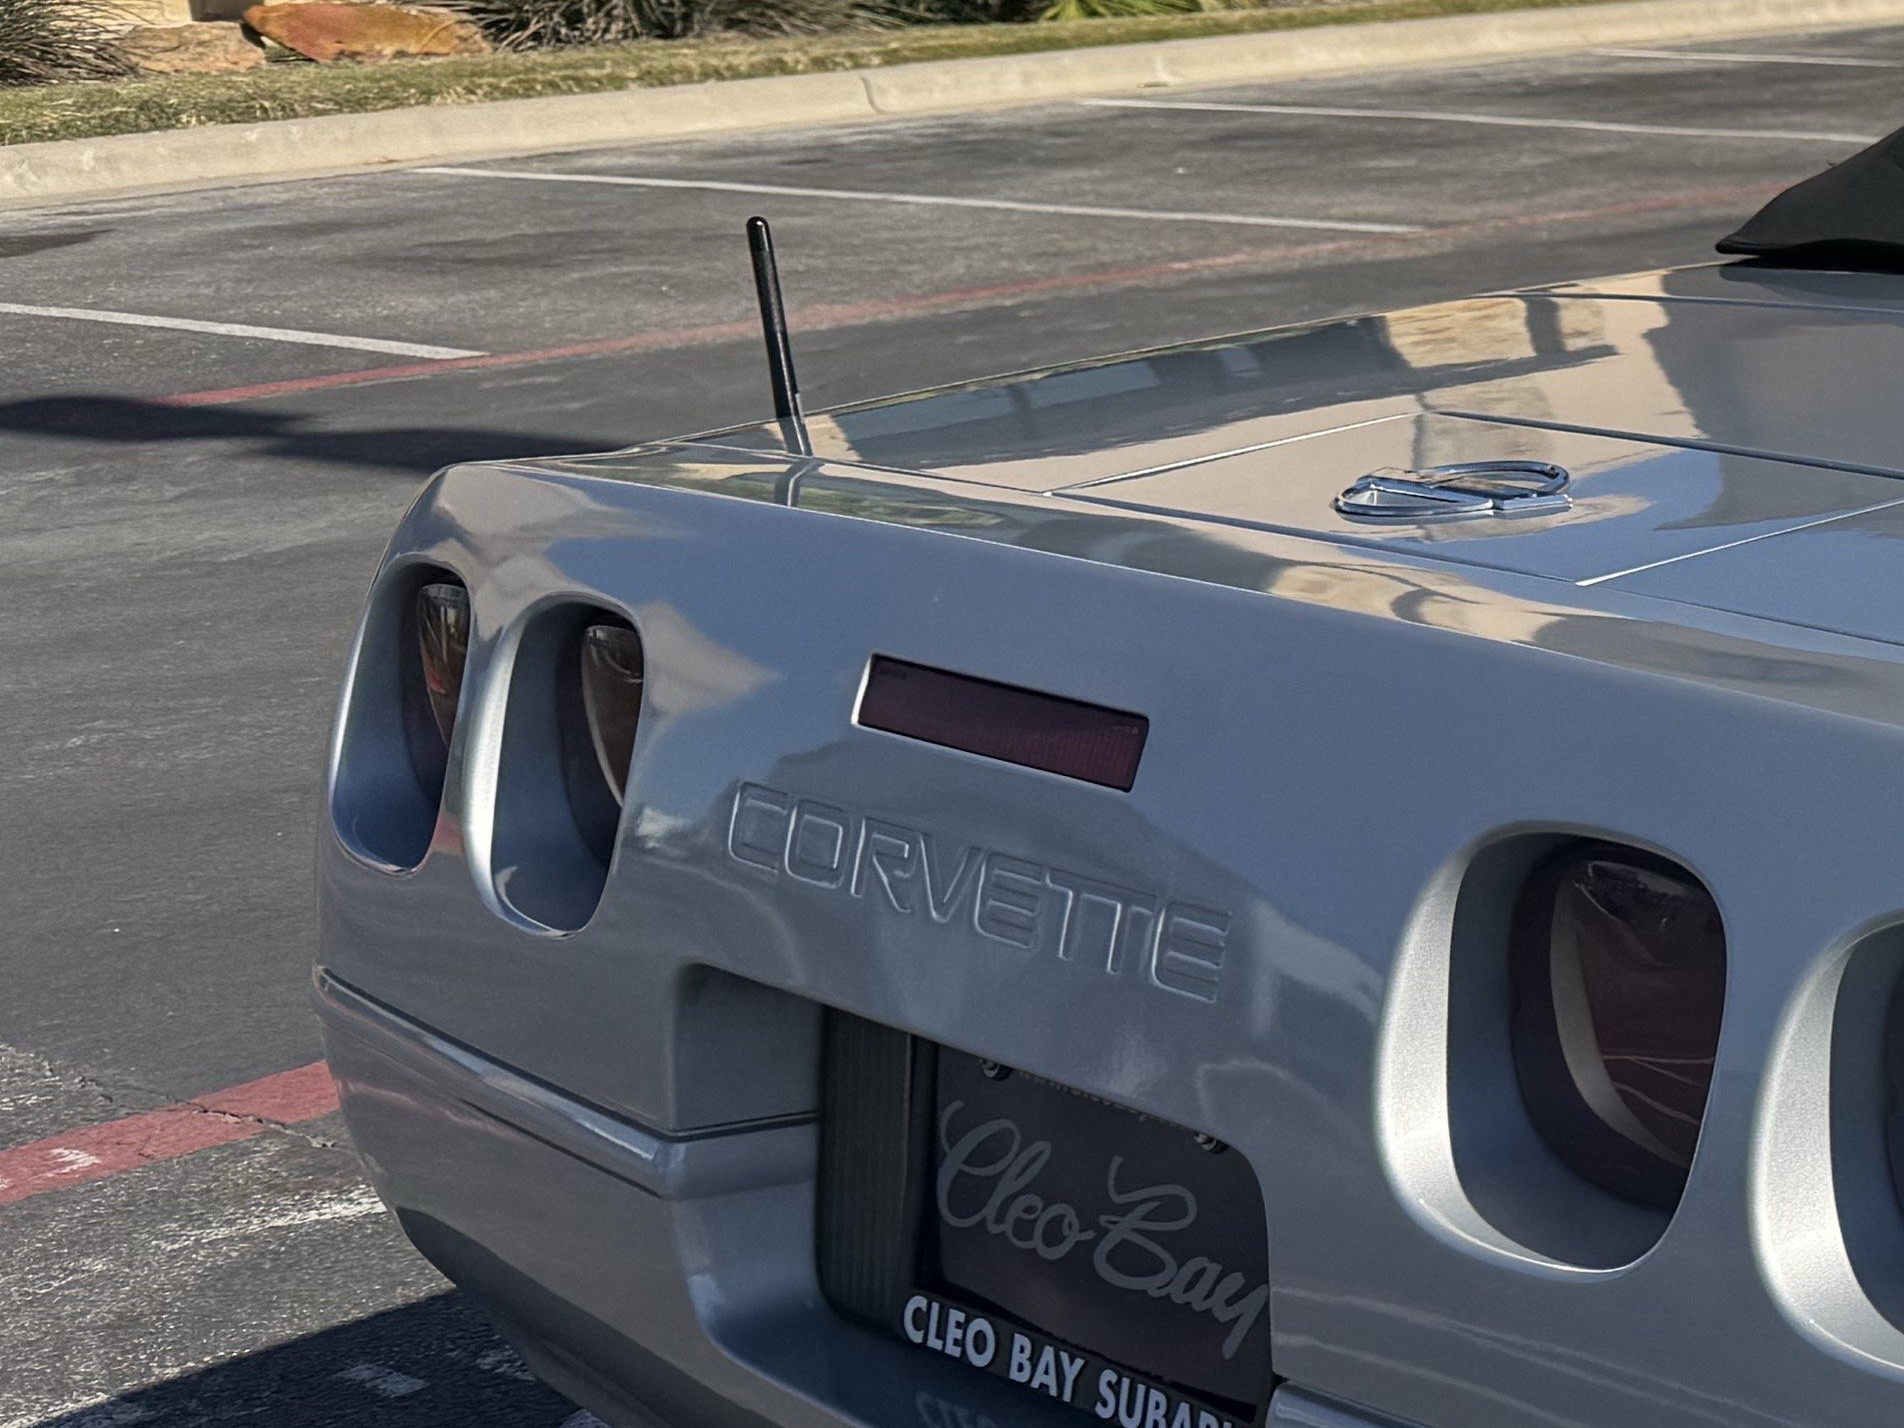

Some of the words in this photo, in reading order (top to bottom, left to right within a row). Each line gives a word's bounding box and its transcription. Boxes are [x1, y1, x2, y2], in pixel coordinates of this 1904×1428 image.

[728, 780, 1233, 1003] CORVETTE
[936, 1099, 1096, 1260] Cleo
[1093, 1155, 1271, 1360] Bay
[902, 1294, 997, 1368] CLEO
[1008, 1332, 1087, 1403] BAY
